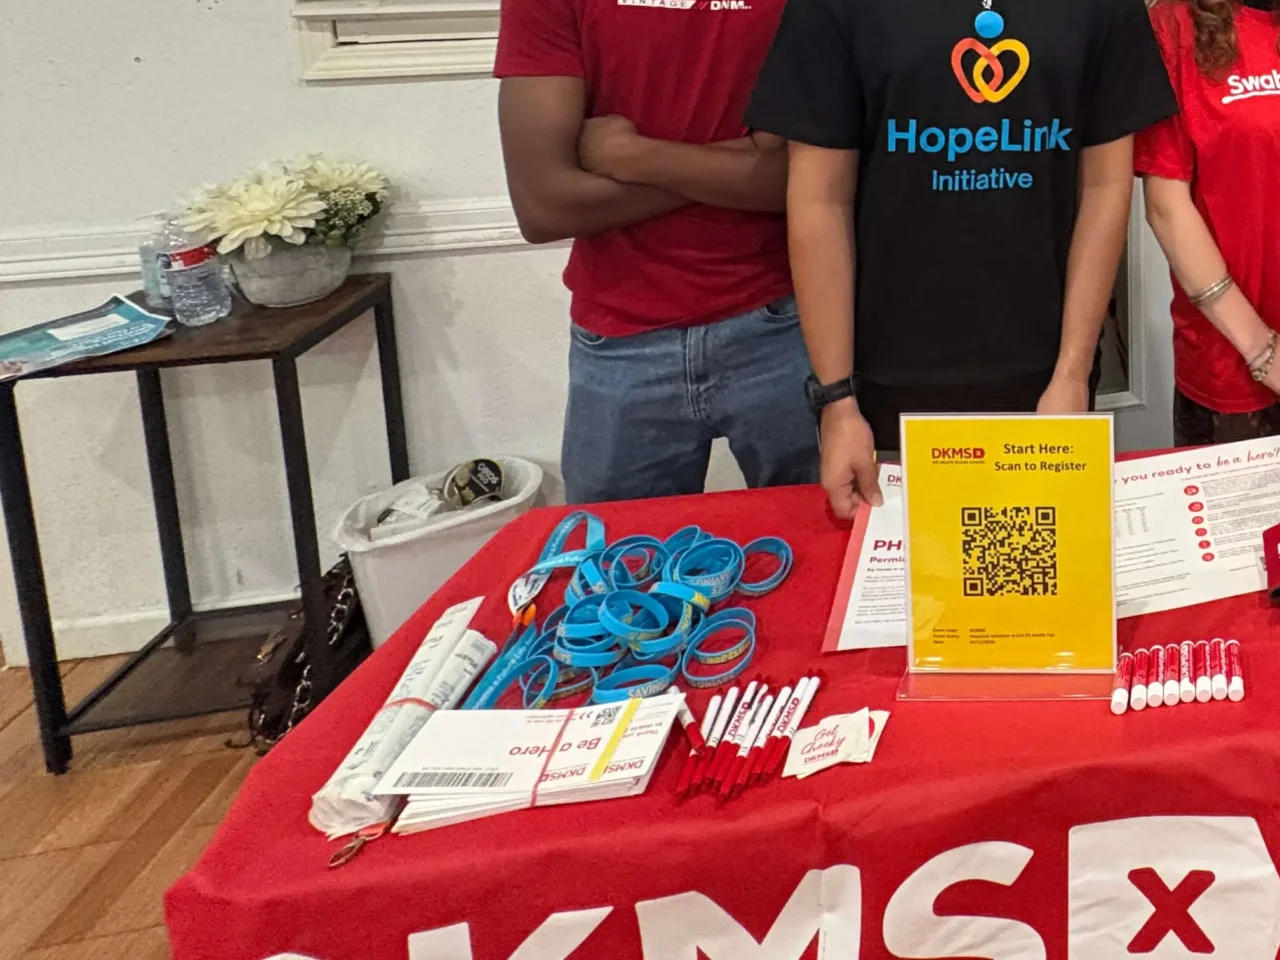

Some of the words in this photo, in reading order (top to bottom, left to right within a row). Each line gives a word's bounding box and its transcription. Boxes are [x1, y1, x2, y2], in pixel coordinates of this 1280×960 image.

[887, 118, 1073, 162] HopeLink
[932, 168, 1033, 191] Initiative
[1003, 443, 1035, 454] Start
[1039, 443, 1074, 454] Here:
[994, 461, 1021, 471] Scan
[1025, 462, 1037, 471] to
[1040, 461, 1087, 473] Register
[1121, 473, 1148, 484] you
[1152, 466, 1192, 479] ready
[1196, 461, 1211, 470] to
[1216, 456, 1230, 467] be
[1232, 456, 1242, 464] a
[1247, 447, 1280, 463] hero?
[814, 724, 838, 741] Get
[558, 741, 572, 753] a
[577, 737, 601, 751] Be
[801, 735, 846, 756] Cheeky
